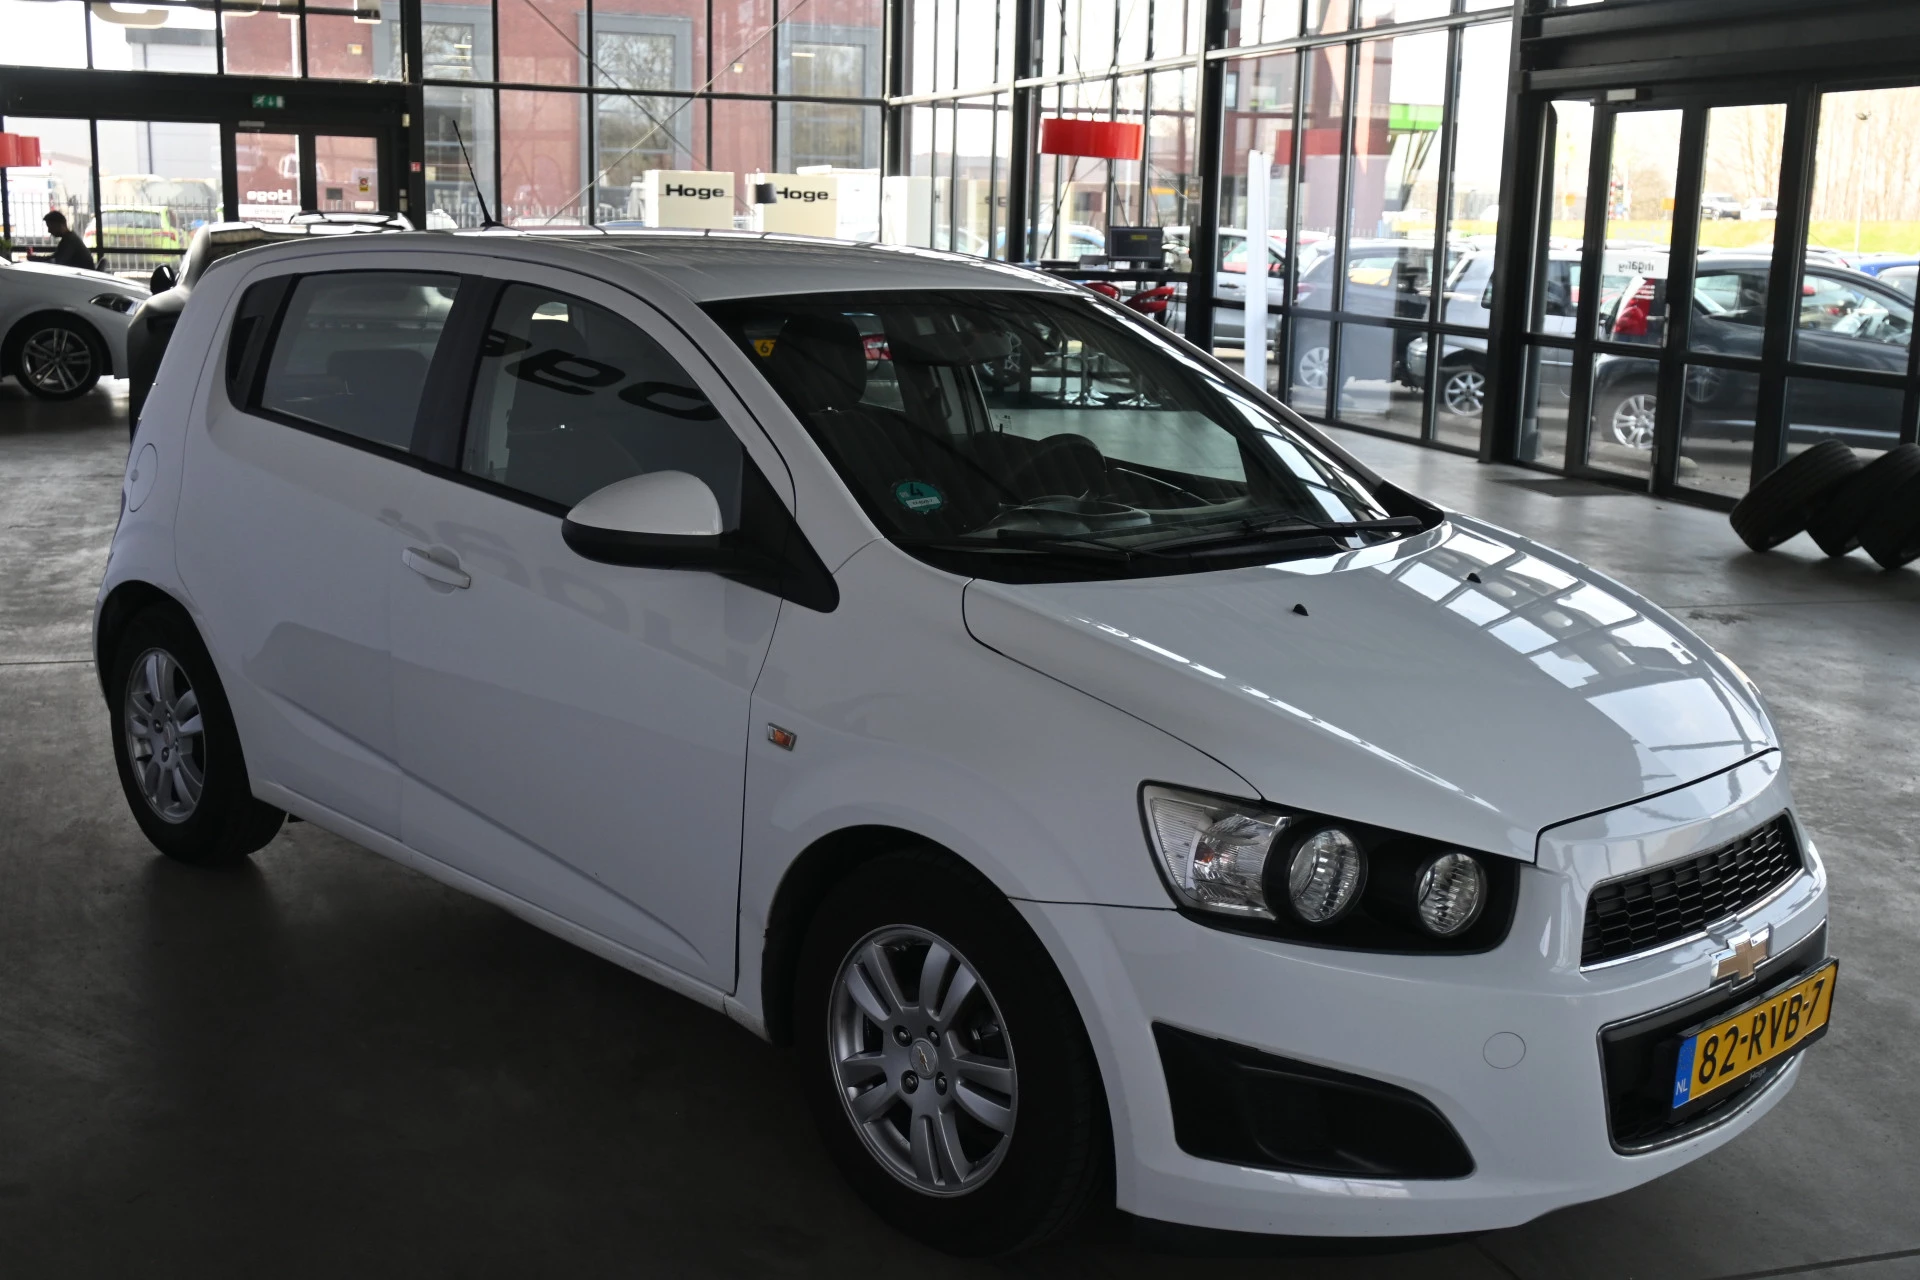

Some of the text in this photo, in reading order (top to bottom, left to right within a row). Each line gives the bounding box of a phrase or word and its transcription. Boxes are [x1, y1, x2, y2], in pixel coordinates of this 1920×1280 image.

[665, 184, 725, 200] Hoge
[1698, 977, 1826, 1085] 82-RVB-7
[1675, 1077, 1689, 1096] NL
